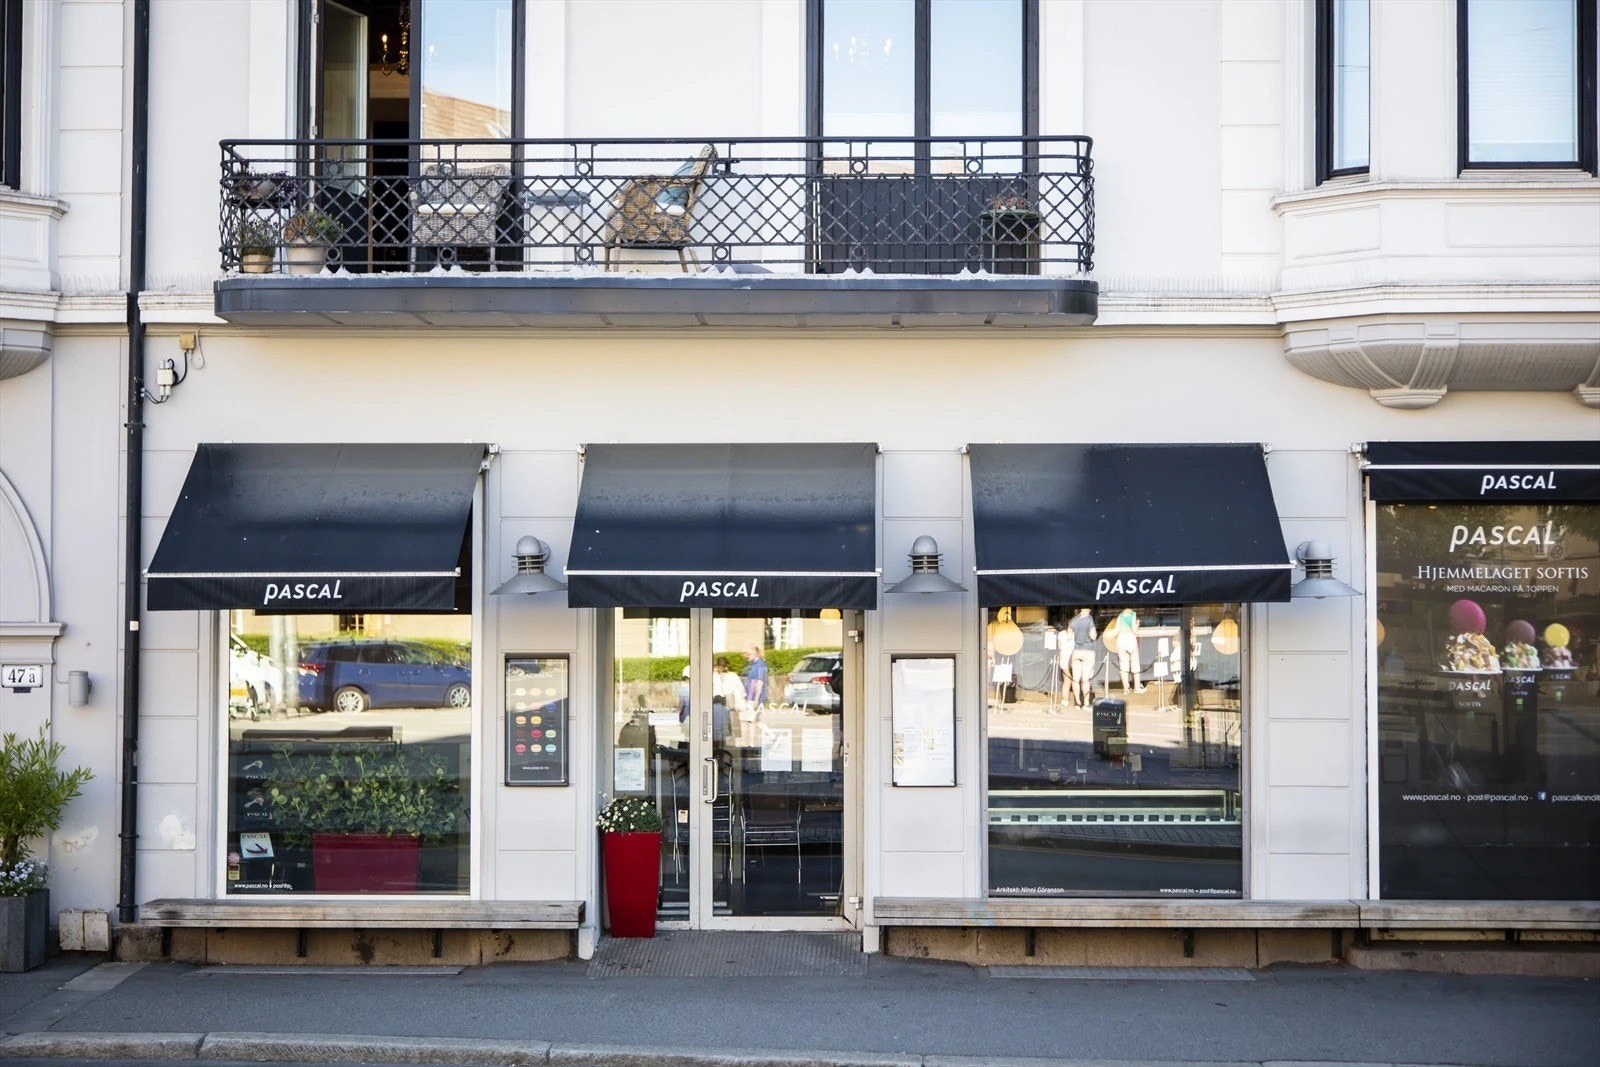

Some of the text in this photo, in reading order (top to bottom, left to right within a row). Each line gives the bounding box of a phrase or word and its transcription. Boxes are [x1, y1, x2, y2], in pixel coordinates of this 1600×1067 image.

[1446, 584, 1560, 593] MED MACARON PÅ TOPPEN
[8, 668, 26, 683] 47
[1402, 793, 1462, 803] www.pascal.no
[1467, 793, 1529, 803] post@pascal.no
